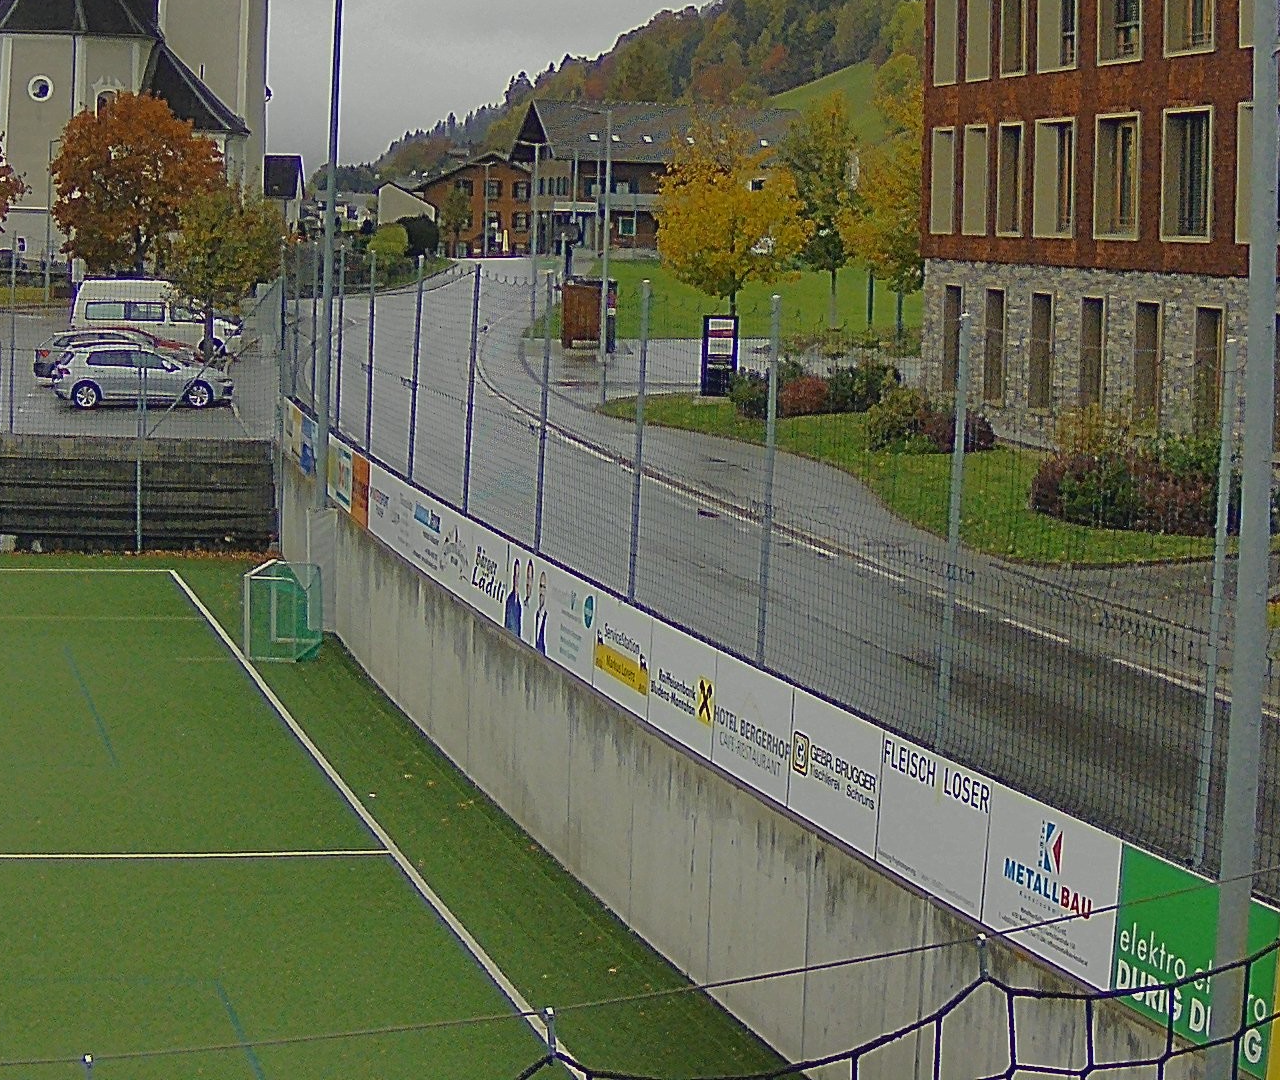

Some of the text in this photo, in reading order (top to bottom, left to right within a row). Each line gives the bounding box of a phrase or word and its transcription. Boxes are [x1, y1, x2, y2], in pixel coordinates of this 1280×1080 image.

[658, 668, 696, 701] Raiffeisenbank
[714, 704, 792, 761] HOTEL BERGERHOF
[835, 757, 876, 794] BRUGGER
[846, 783, 875, 810] Schruns
[884, 739, 990, 814] FLEISCH LOSER
[1004, 857, 1093, 920] METALLBAU
[1120, 922, 1186, 980] elektro
